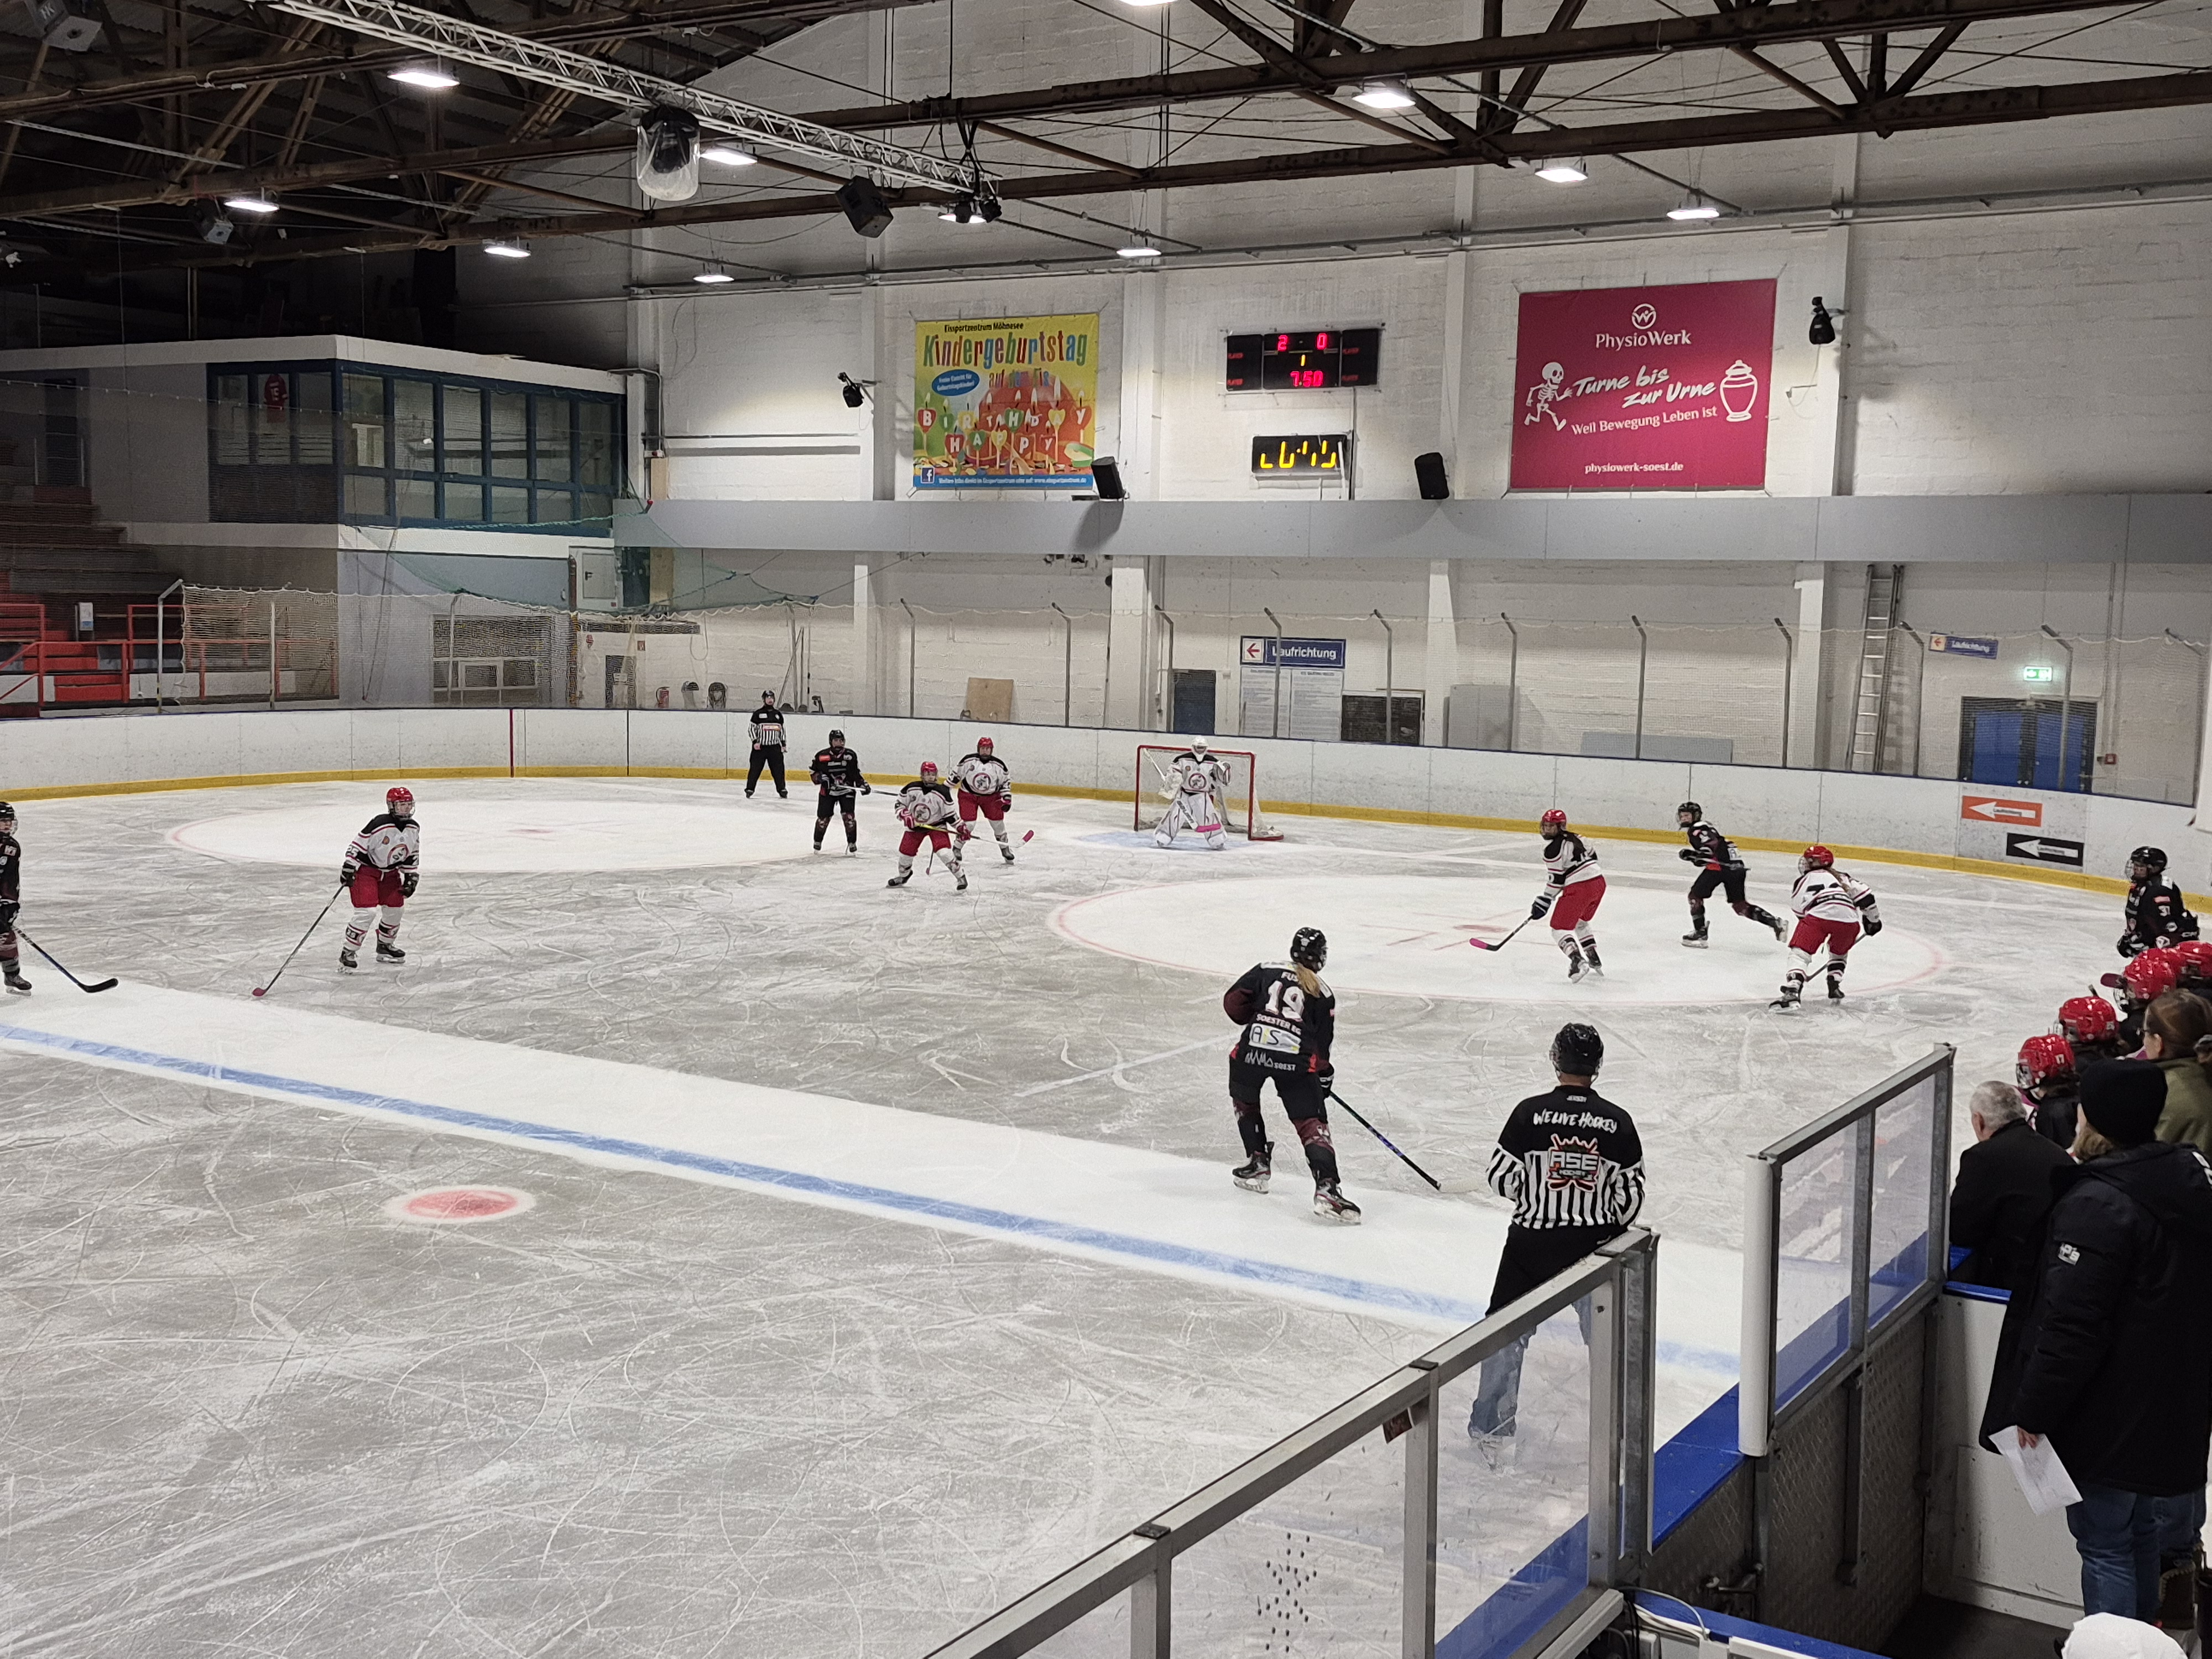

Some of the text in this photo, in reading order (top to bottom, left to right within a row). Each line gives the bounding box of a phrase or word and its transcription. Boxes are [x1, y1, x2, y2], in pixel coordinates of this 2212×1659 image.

[923, 330, 1088, 369] Kindergeburtstag
[1277, 333, 1327, 351] 2 0
[1595, 330, 1692, 352] PhysioWerk
[989, 369, 1005, 388] auf
[1034, 368, 1050, 388] Eis
[1572, 365, 1670, 397] Turne bis
[1666, 381, 1717, 403] Urne
[1599, 415, 1660, 430] Bewegung
[1663, 410, 1699, 423] Leben
[1703, 405, 1718, 418] ist
[1584, 461, 1684, 474] physiowerk-soest.de
[1272, 645, 1337, 660] Laufrichtung
[1265, 980, 1305, 1022] 19
[1256, 1013, 1291, 1030] SOESTER
[1274, 1062, 1296, 1072] SOEST
[1578, 1112, 1618, 1134] HOCKEY
[1550, 1151, 1598, 1171] ASE
